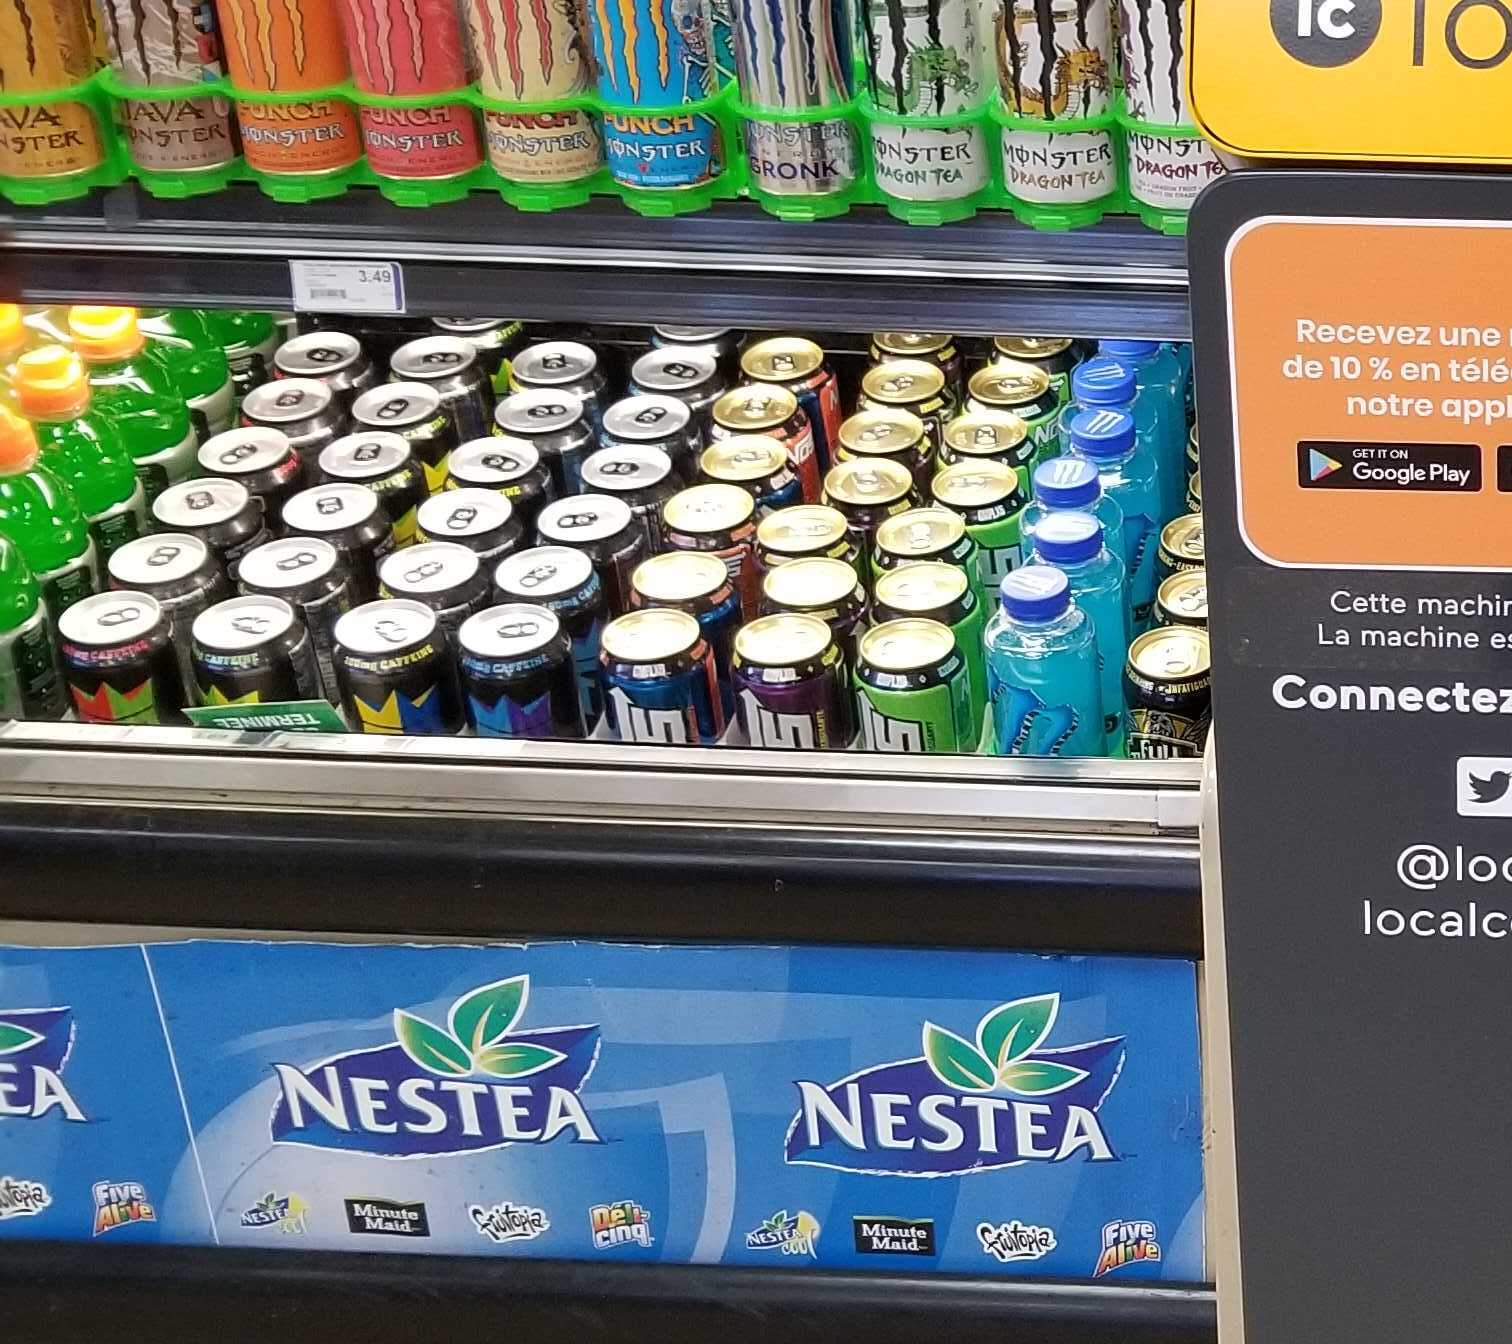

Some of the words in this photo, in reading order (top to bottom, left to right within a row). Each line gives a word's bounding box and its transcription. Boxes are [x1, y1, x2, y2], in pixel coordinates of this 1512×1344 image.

[1010, 165, 1073, 190] DRAGON
[1078, 168, 1106, 189] TEA
[1135, 155, 1198, 179] DRAGON
[358, 269, 391, 284] 3.49
[1296, 319, 1432, 346] Recevez
[1439, 325, 1501, 348] une
[1282, 354, 1324, 380] de
[1329, 357, 1361, 380] 10
[1400, 362, 1441, 382] en
[1346, 395, 1434, 418] notre
[1352, 448, 1376, 459] GET
[1389, 449, 1409, 460] ON
[1352, 462, 1426, 486] Google
[1429, 464, 1471, 487] Play
[1331, 590, 1407, 614] Cette
[1318, 623, 1350, 645] La
[1361, 626, 1480, 649] machine
[274, 1063, 606, 1145] NESTEA
[795, 1082, 1121, 1162] NESTEA
[862, 1223, 928, 1241] Minute
[872, 1236, 920, 1252] Maid
[1105, 1221, 1155, 1245] Five
[1096, 1241, 1161, 1274] Alive
